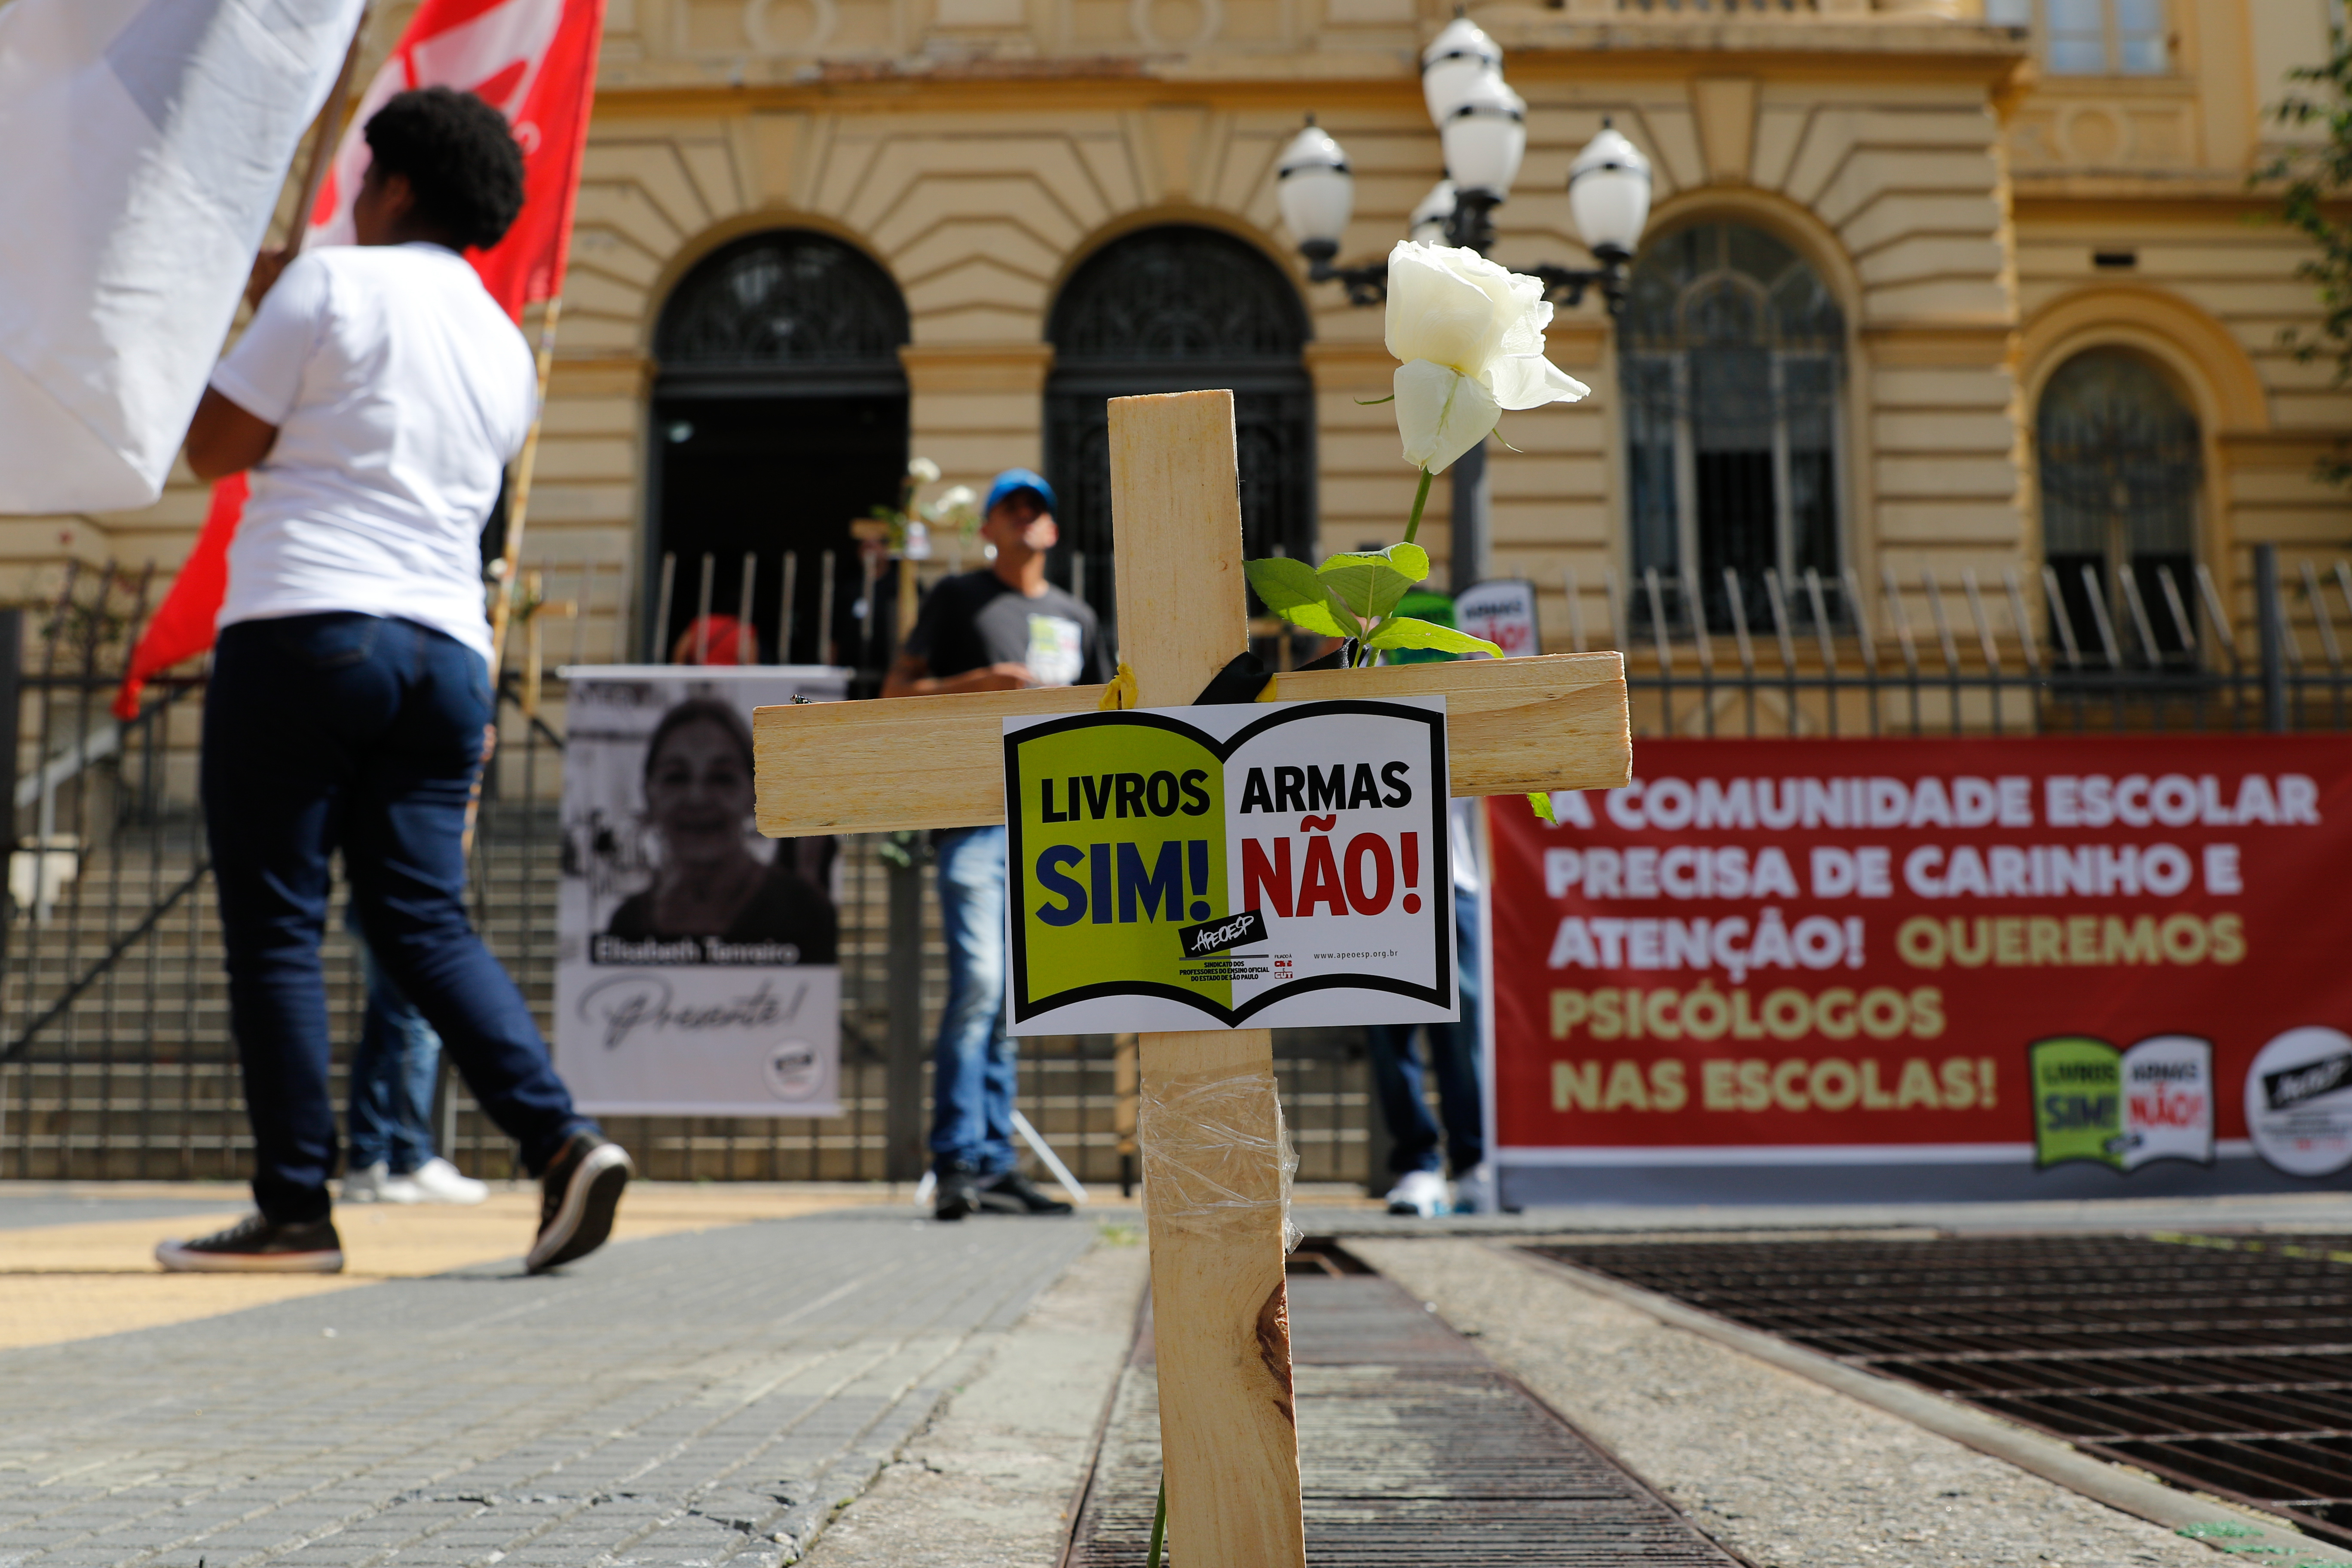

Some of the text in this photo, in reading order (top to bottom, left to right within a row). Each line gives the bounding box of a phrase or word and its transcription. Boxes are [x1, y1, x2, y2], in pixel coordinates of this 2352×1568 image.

[1041, 769, 1210, 823] LIVROS
[1240, 761, 1412, 814] ARMAS
[1605, 776, 2033, 830] COMUNIDADE
[2045, 773, 2321, 828] ESCOLAR
[1035, 839, 1211, 927] SIM!
[1241, 814, 1421, 918] NÃO!
[1544, 842, 2243, 899] PRECISA DE CARINHO E
[1191, 916, 1254, 951] APEOESP
[1314, 949, 1398, 959] www.apeoesp.org.br
[1547, 906, 2246, 984] ATENÇÃO! QUEREMOS
[1550, 977, 1945, 1040] PSICÓLOGOS
[1551, 1057, 1997, 1112] NAS ESCOLAS!
